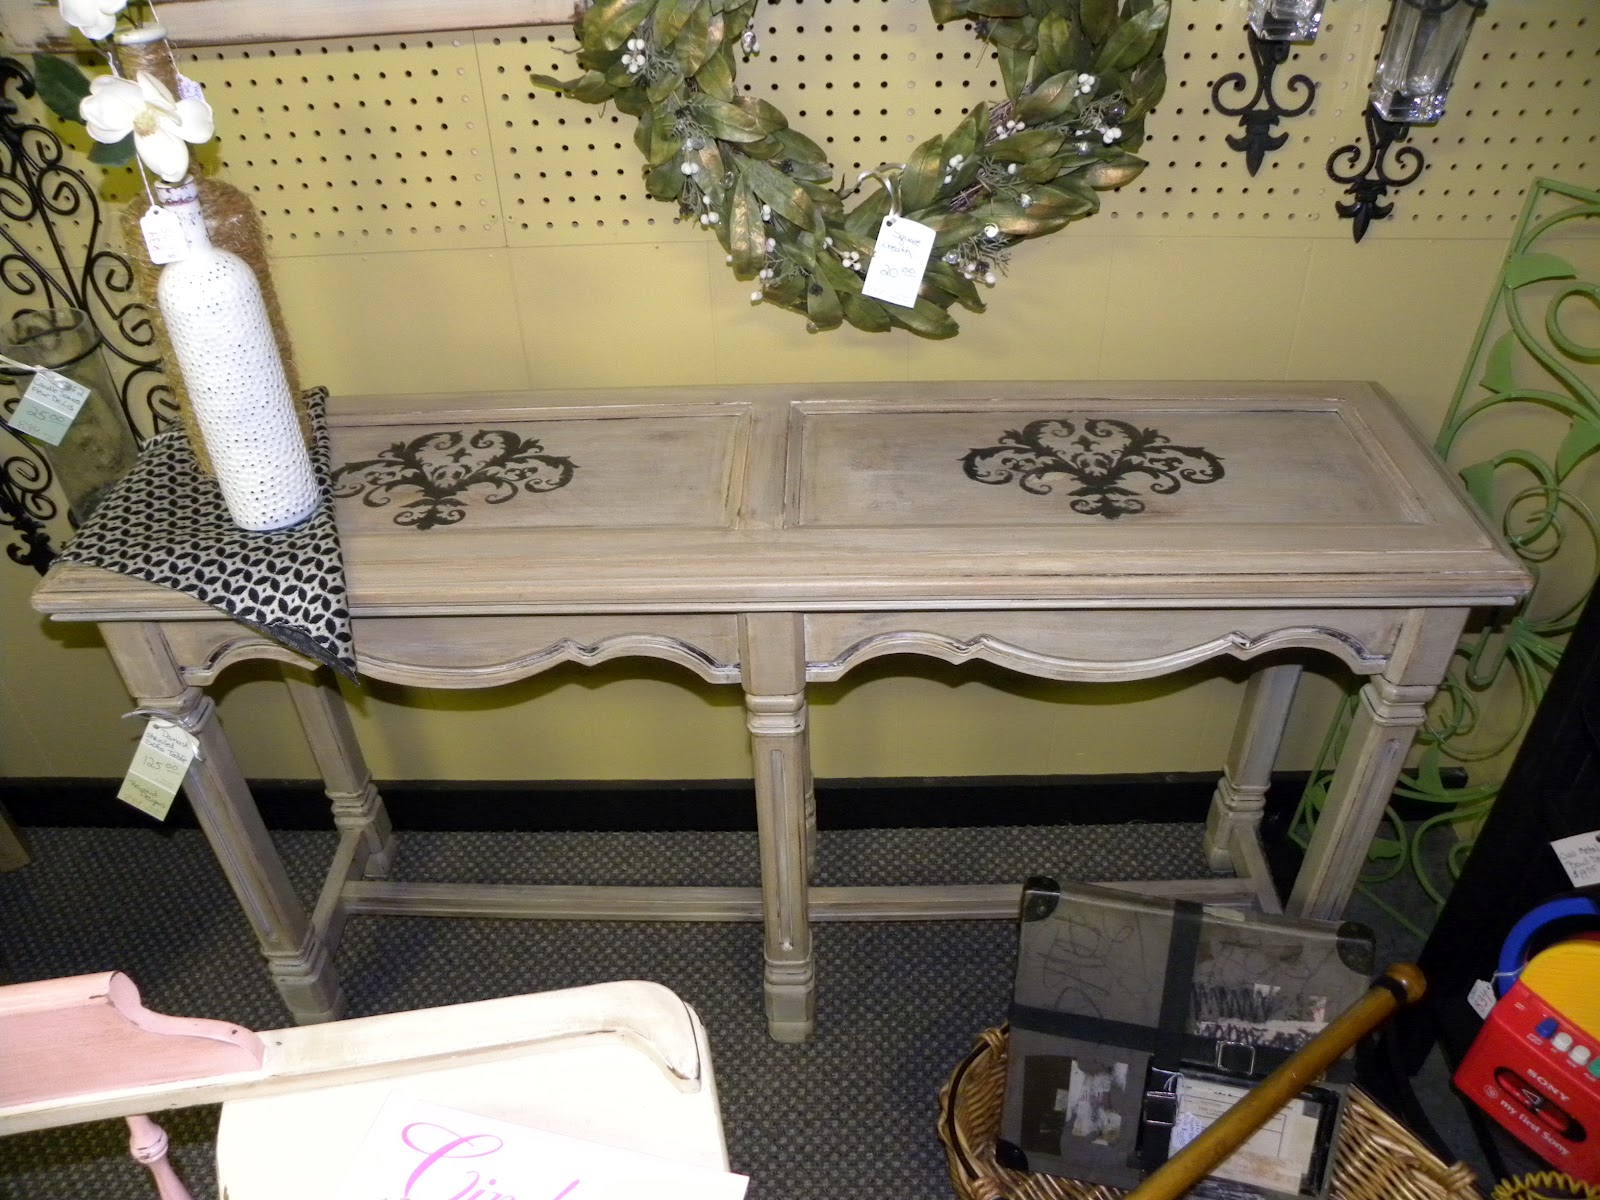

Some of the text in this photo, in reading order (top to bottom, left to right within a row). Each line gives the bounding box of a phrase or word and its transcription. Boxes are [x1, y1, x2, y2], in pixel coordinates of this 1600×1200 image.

[1526, 1068, 1570, 1101] SONY
[1500, 1100, 1570, 1156] my first Sony
